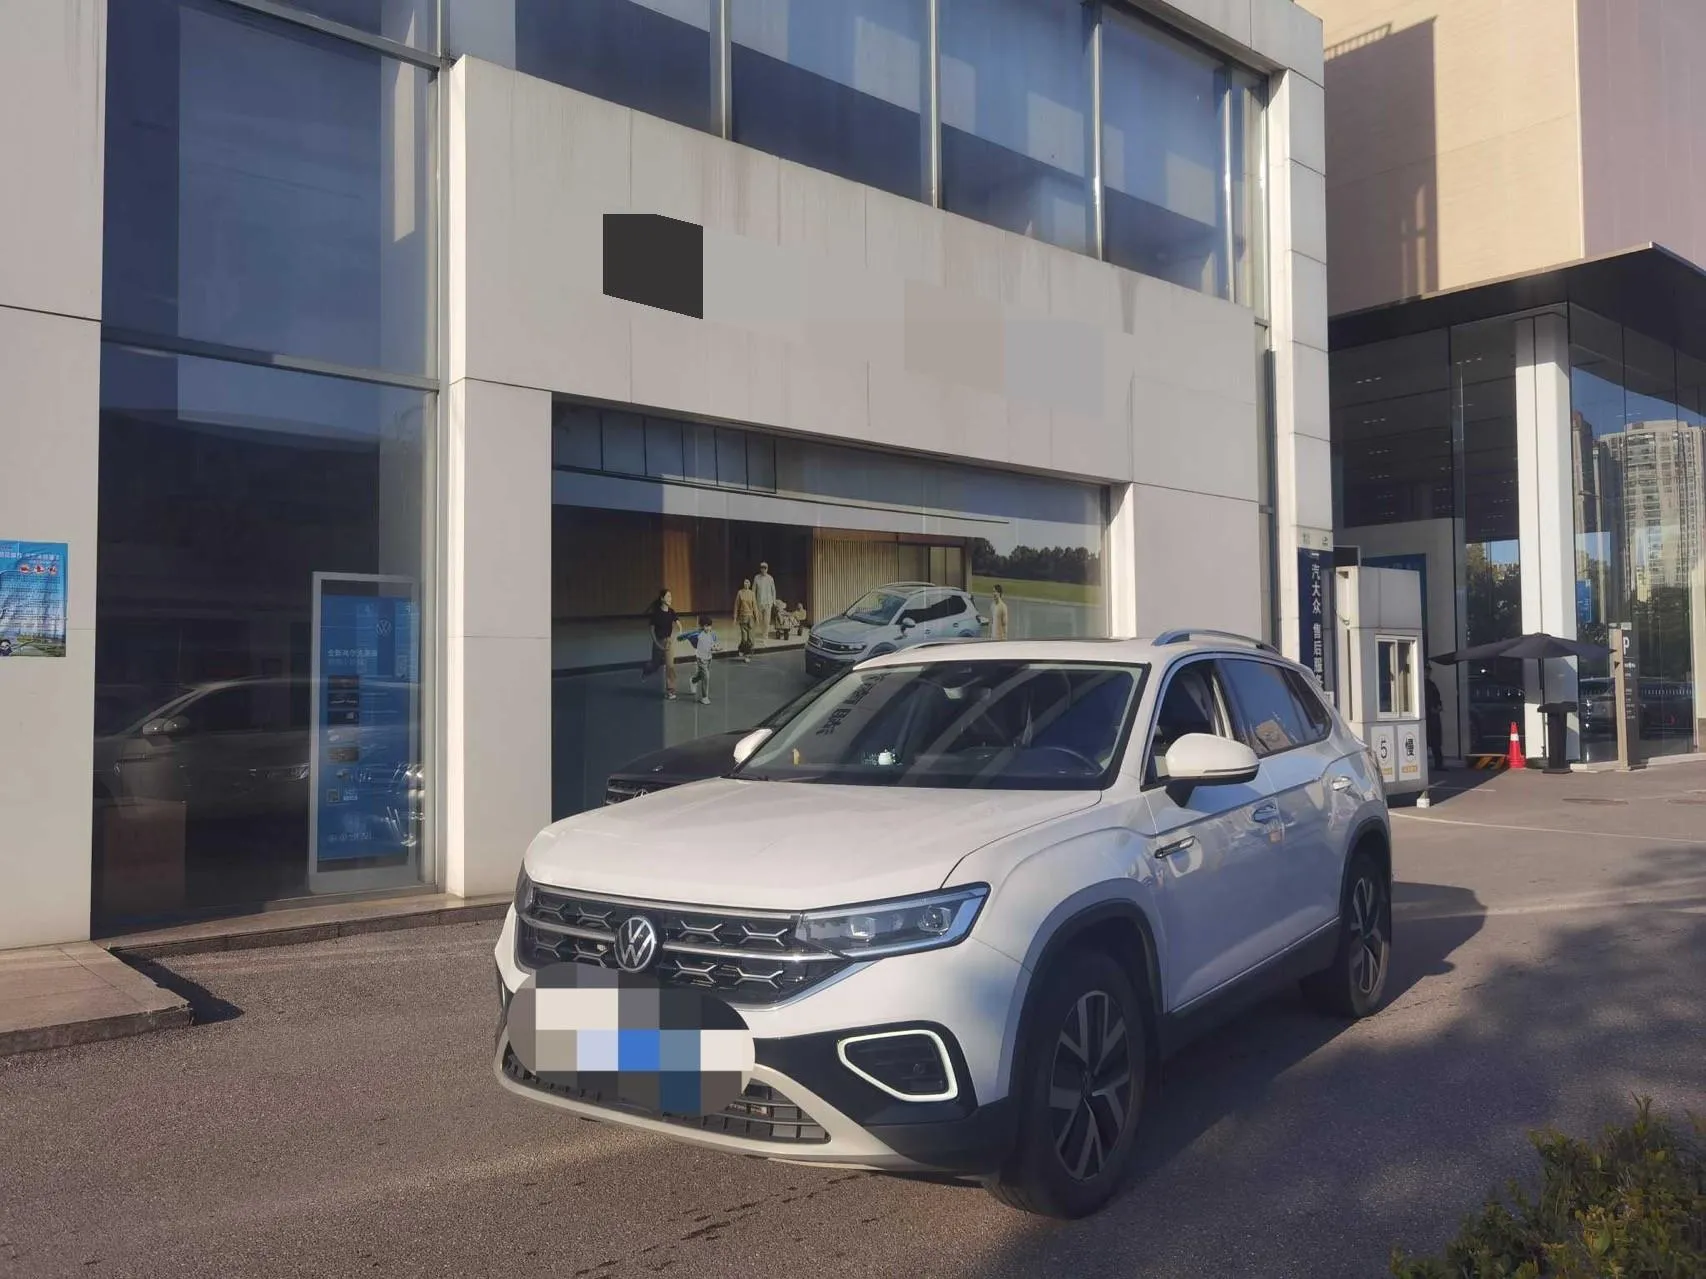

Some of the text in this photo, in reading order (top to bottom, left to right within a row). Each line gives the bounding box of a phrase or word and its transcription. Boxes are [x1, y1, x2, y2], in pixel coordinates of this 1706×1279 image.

[1311, 552, 1321, 615] 一汽大众
[1623, 636, 1630, 655] P
[1380, 739, 1388, 759] 5
